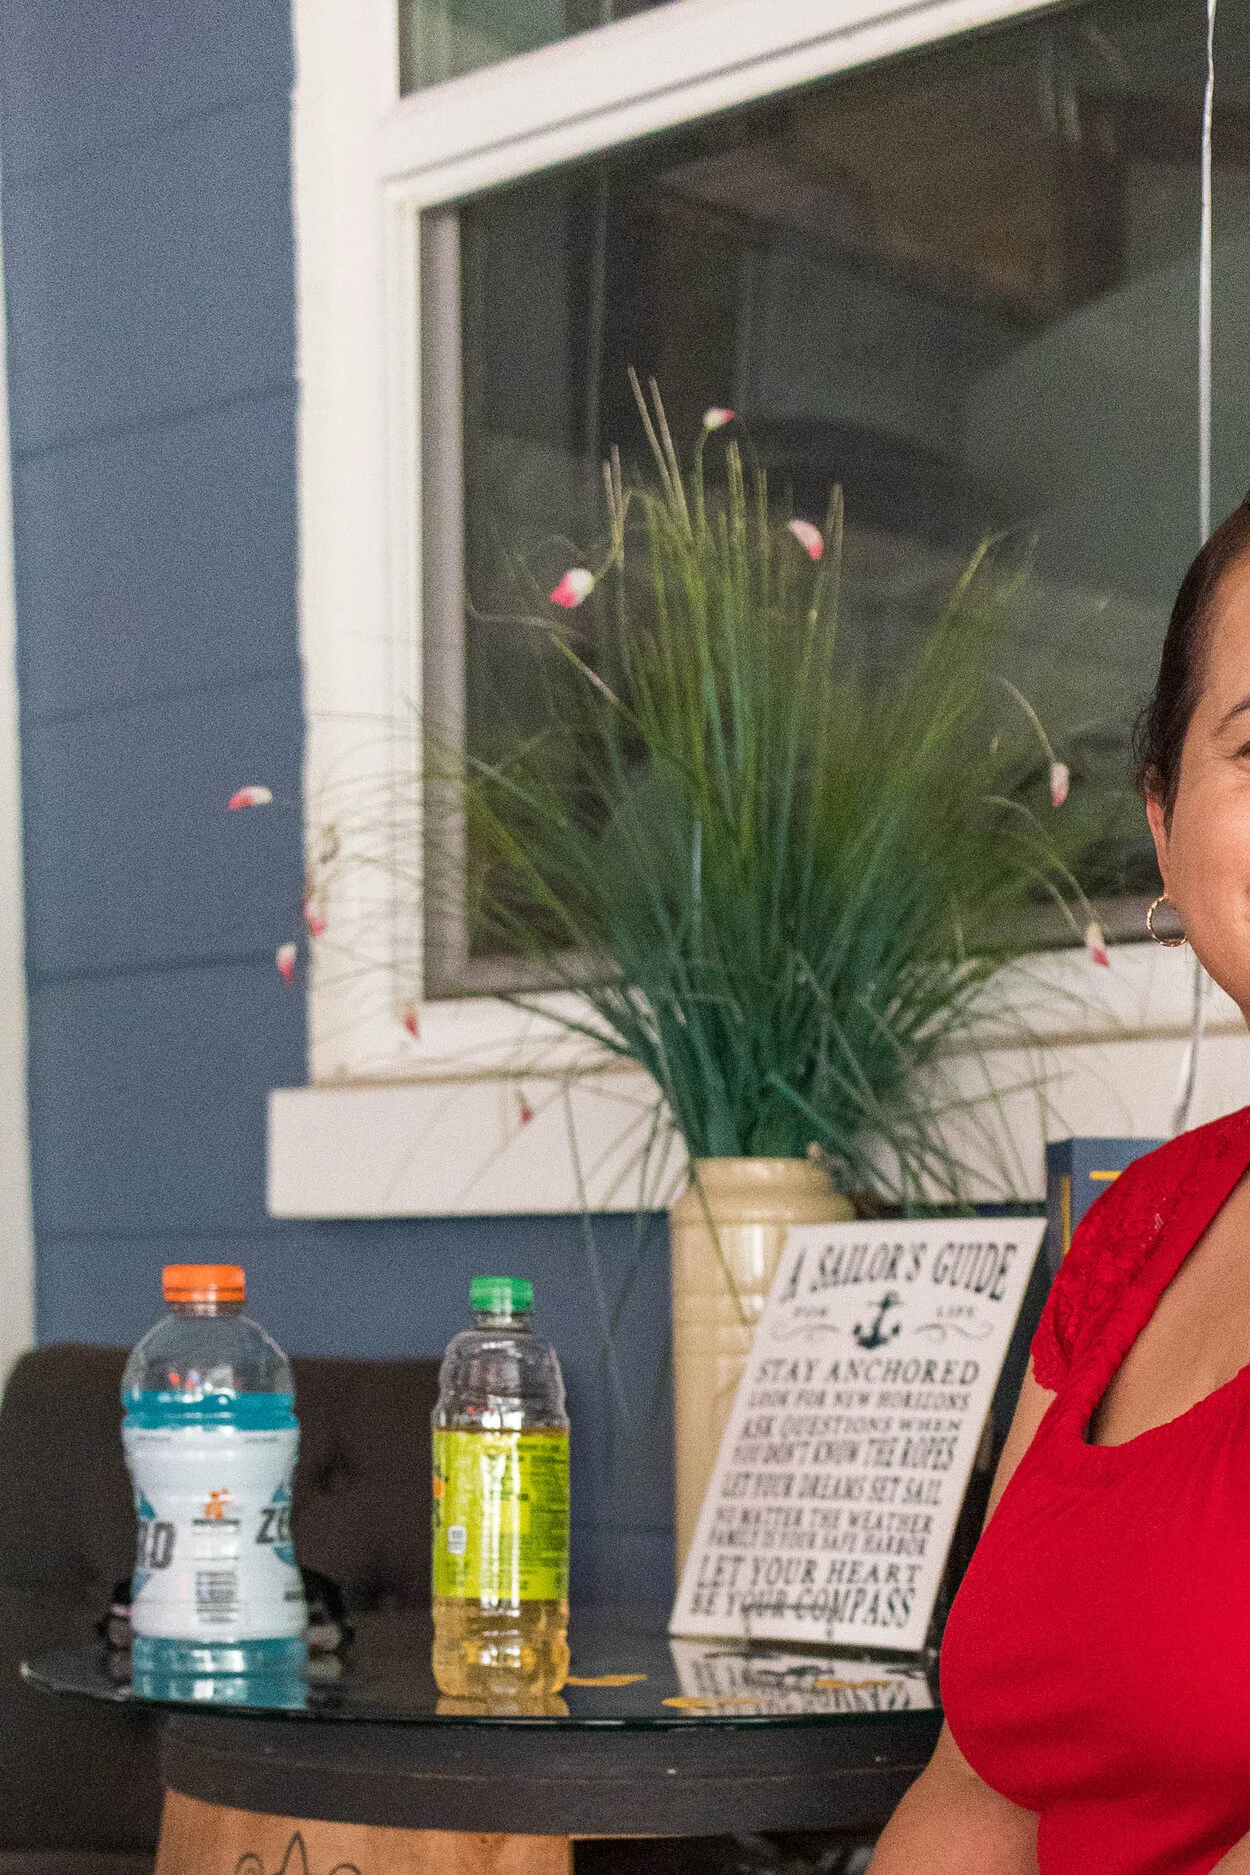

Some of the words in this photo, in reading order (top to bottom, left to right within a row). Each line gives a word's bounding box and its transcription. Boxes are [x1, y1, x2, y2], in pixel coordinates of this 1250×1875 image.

[809, 1241, 928, 1292] SAILOR'S
[932, 1241, 1017, 1301] GUIDE
[756, 1360, 819, 1383] STAY
[824, 1360, 980, 1384] ANCHORED
[794, 1391, 824, 1407] FOR
[832, 1392, 868, 1407] NEW
[876, 1392, 969, 1410] HORIZONS
[740, 1416, 774, 1437] ASK
[780, 1418, 891, 1439] QUESTIONS
[898, 1420, 959, 1431] WHEN
[812, 1440, 859, 1465] KNOW
[862, 1439, 896, 1466] THE
[898, 1439, 956, 1470] ROPES
[722, 1474, 749, 1497] LET
[752, 1475, 793, 1498] YOUR
[797, 1476, 865, 1501] DREAMS
[868, 1478, 899, 1502] SET
[902, 1481, 944, 1505] SAIL
[740, 1508, 801, 1526] MATTER
[809, 1510, 840, 1529] THE
[845, 1512, 932, 1533] WEATHER
[696, 1555, 743, 1588] LET
[748, 1558, 817, 1585] YOUR
[826, 1563, 919, 1587] HEART
[690, 1589, 719, 1614] BE
[724, 1590, 786, 1619] YOUR
[793, 1583, 914, 1627] COMPASS
